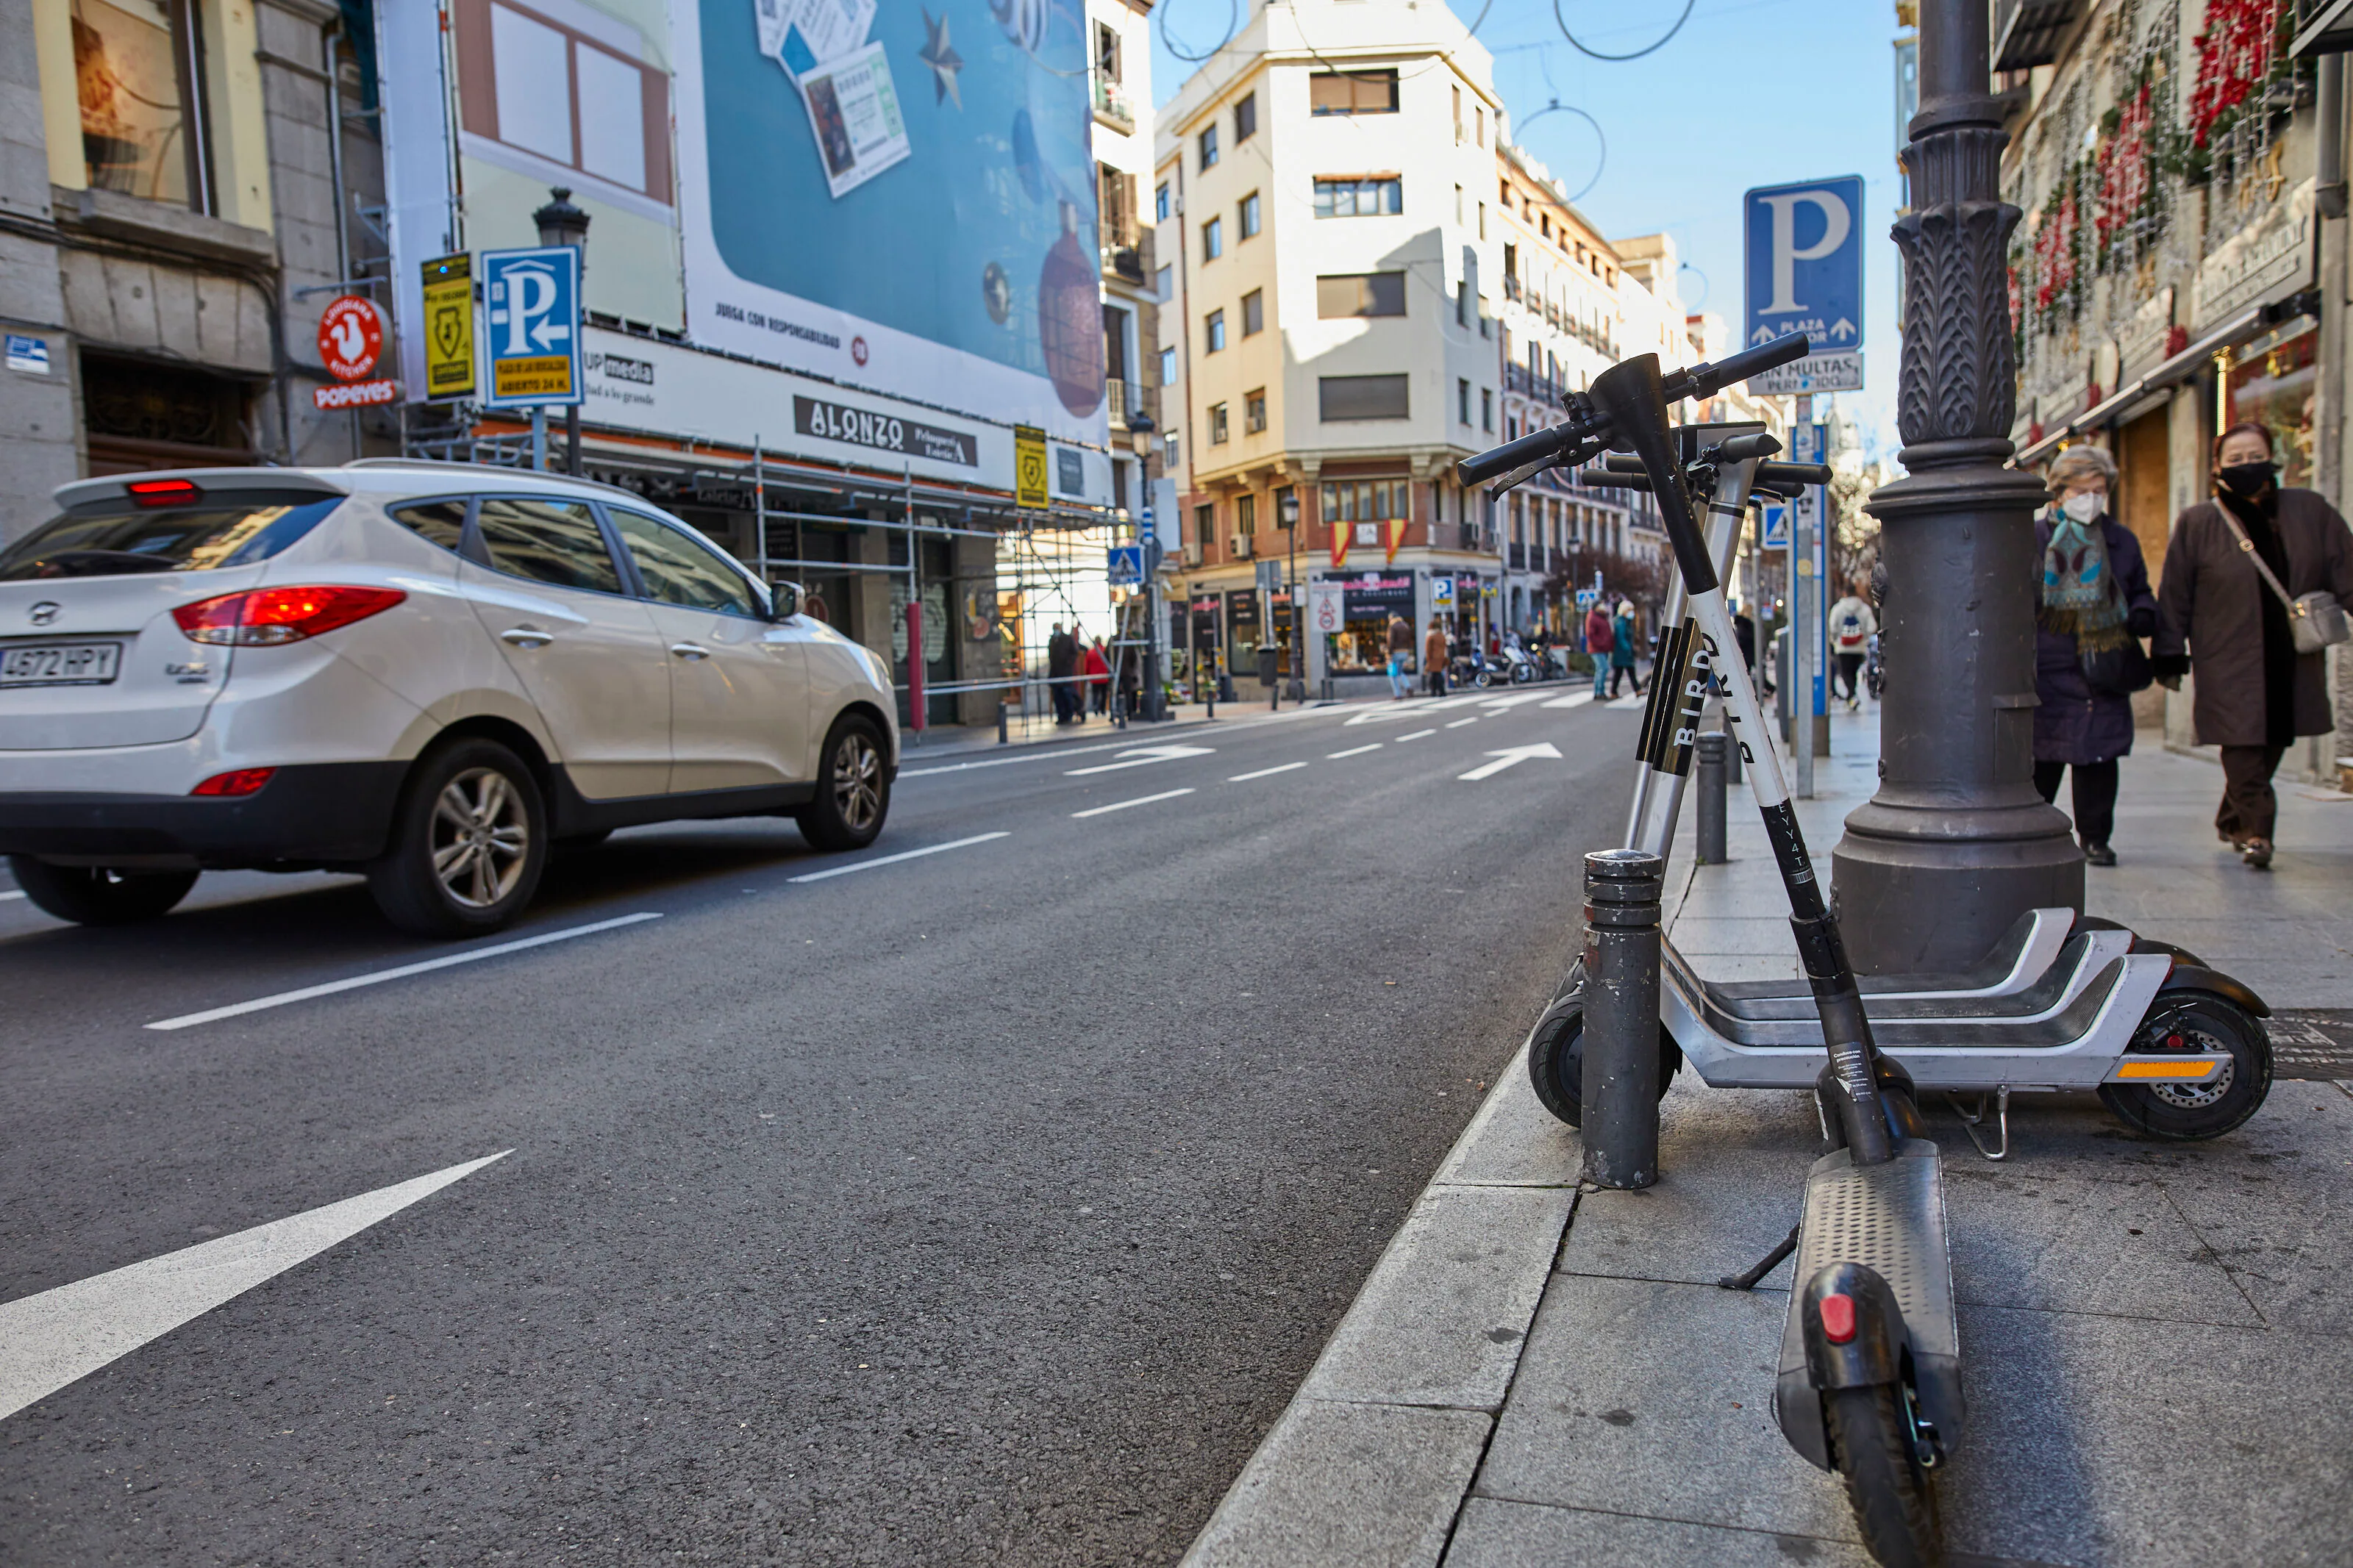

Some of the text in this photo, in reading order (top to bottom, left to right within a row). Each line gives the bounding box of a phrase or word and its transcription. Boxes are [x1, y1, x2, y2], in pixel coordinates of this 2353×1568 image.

[1757, 190, 1850, 315] P
[324, 298, 374, 326] LOUISIANA
[501, 271, 557, 354] P
[715, 302, 840, 349] JUEGA CON RESPONSABILIDAD
[1780, 318, 1826, 333] PLAZA
[330, 354, 374, 378] KITCHEN
[810, 401, 904, 451] ALONZO
[63, 648, 113, 675] HPY
[1673, 650, 1712, 747] BIRD
